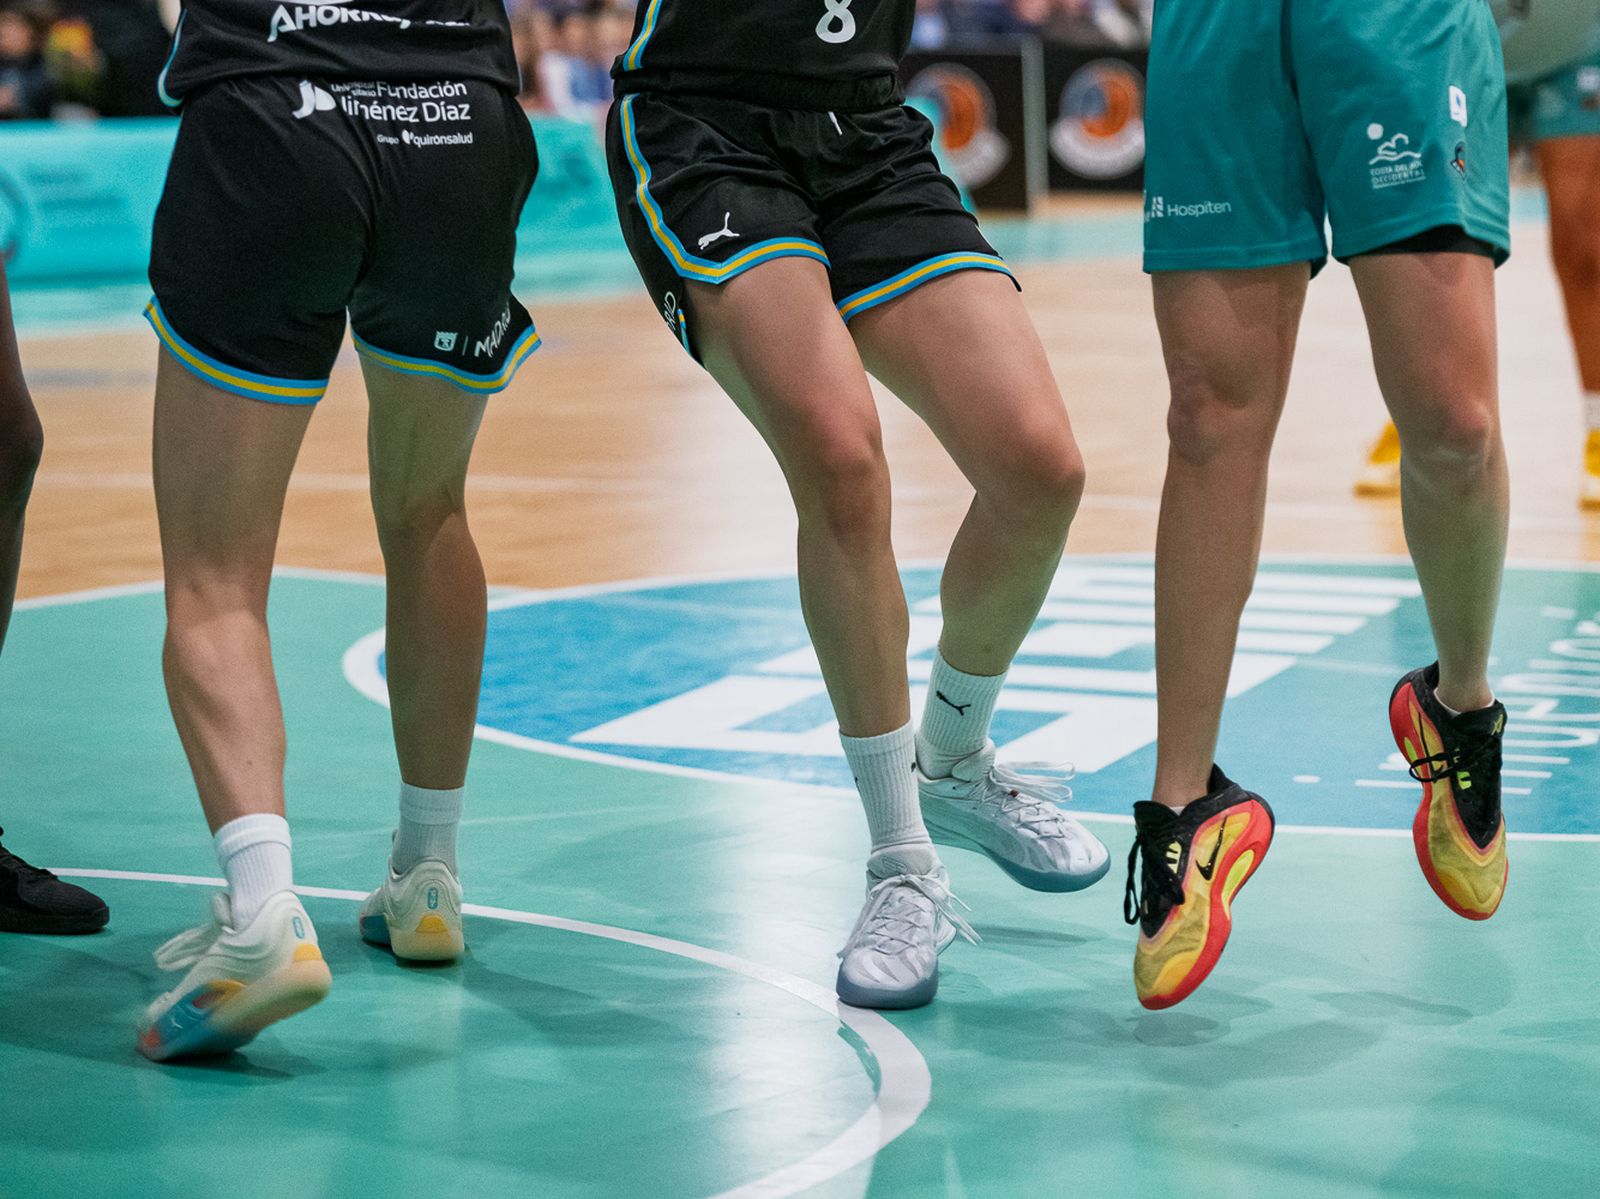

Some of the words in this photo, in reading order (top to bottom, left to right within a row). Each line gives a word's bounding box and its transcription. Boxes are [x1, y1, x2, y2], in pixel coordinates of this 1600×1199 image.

[376, 81, 468, 100] Fundación
[422, 100, 471, 123] Díaz
[376, 134, 400, 145] Grupo
[1167, 201, 1232, 218] Hospiten
